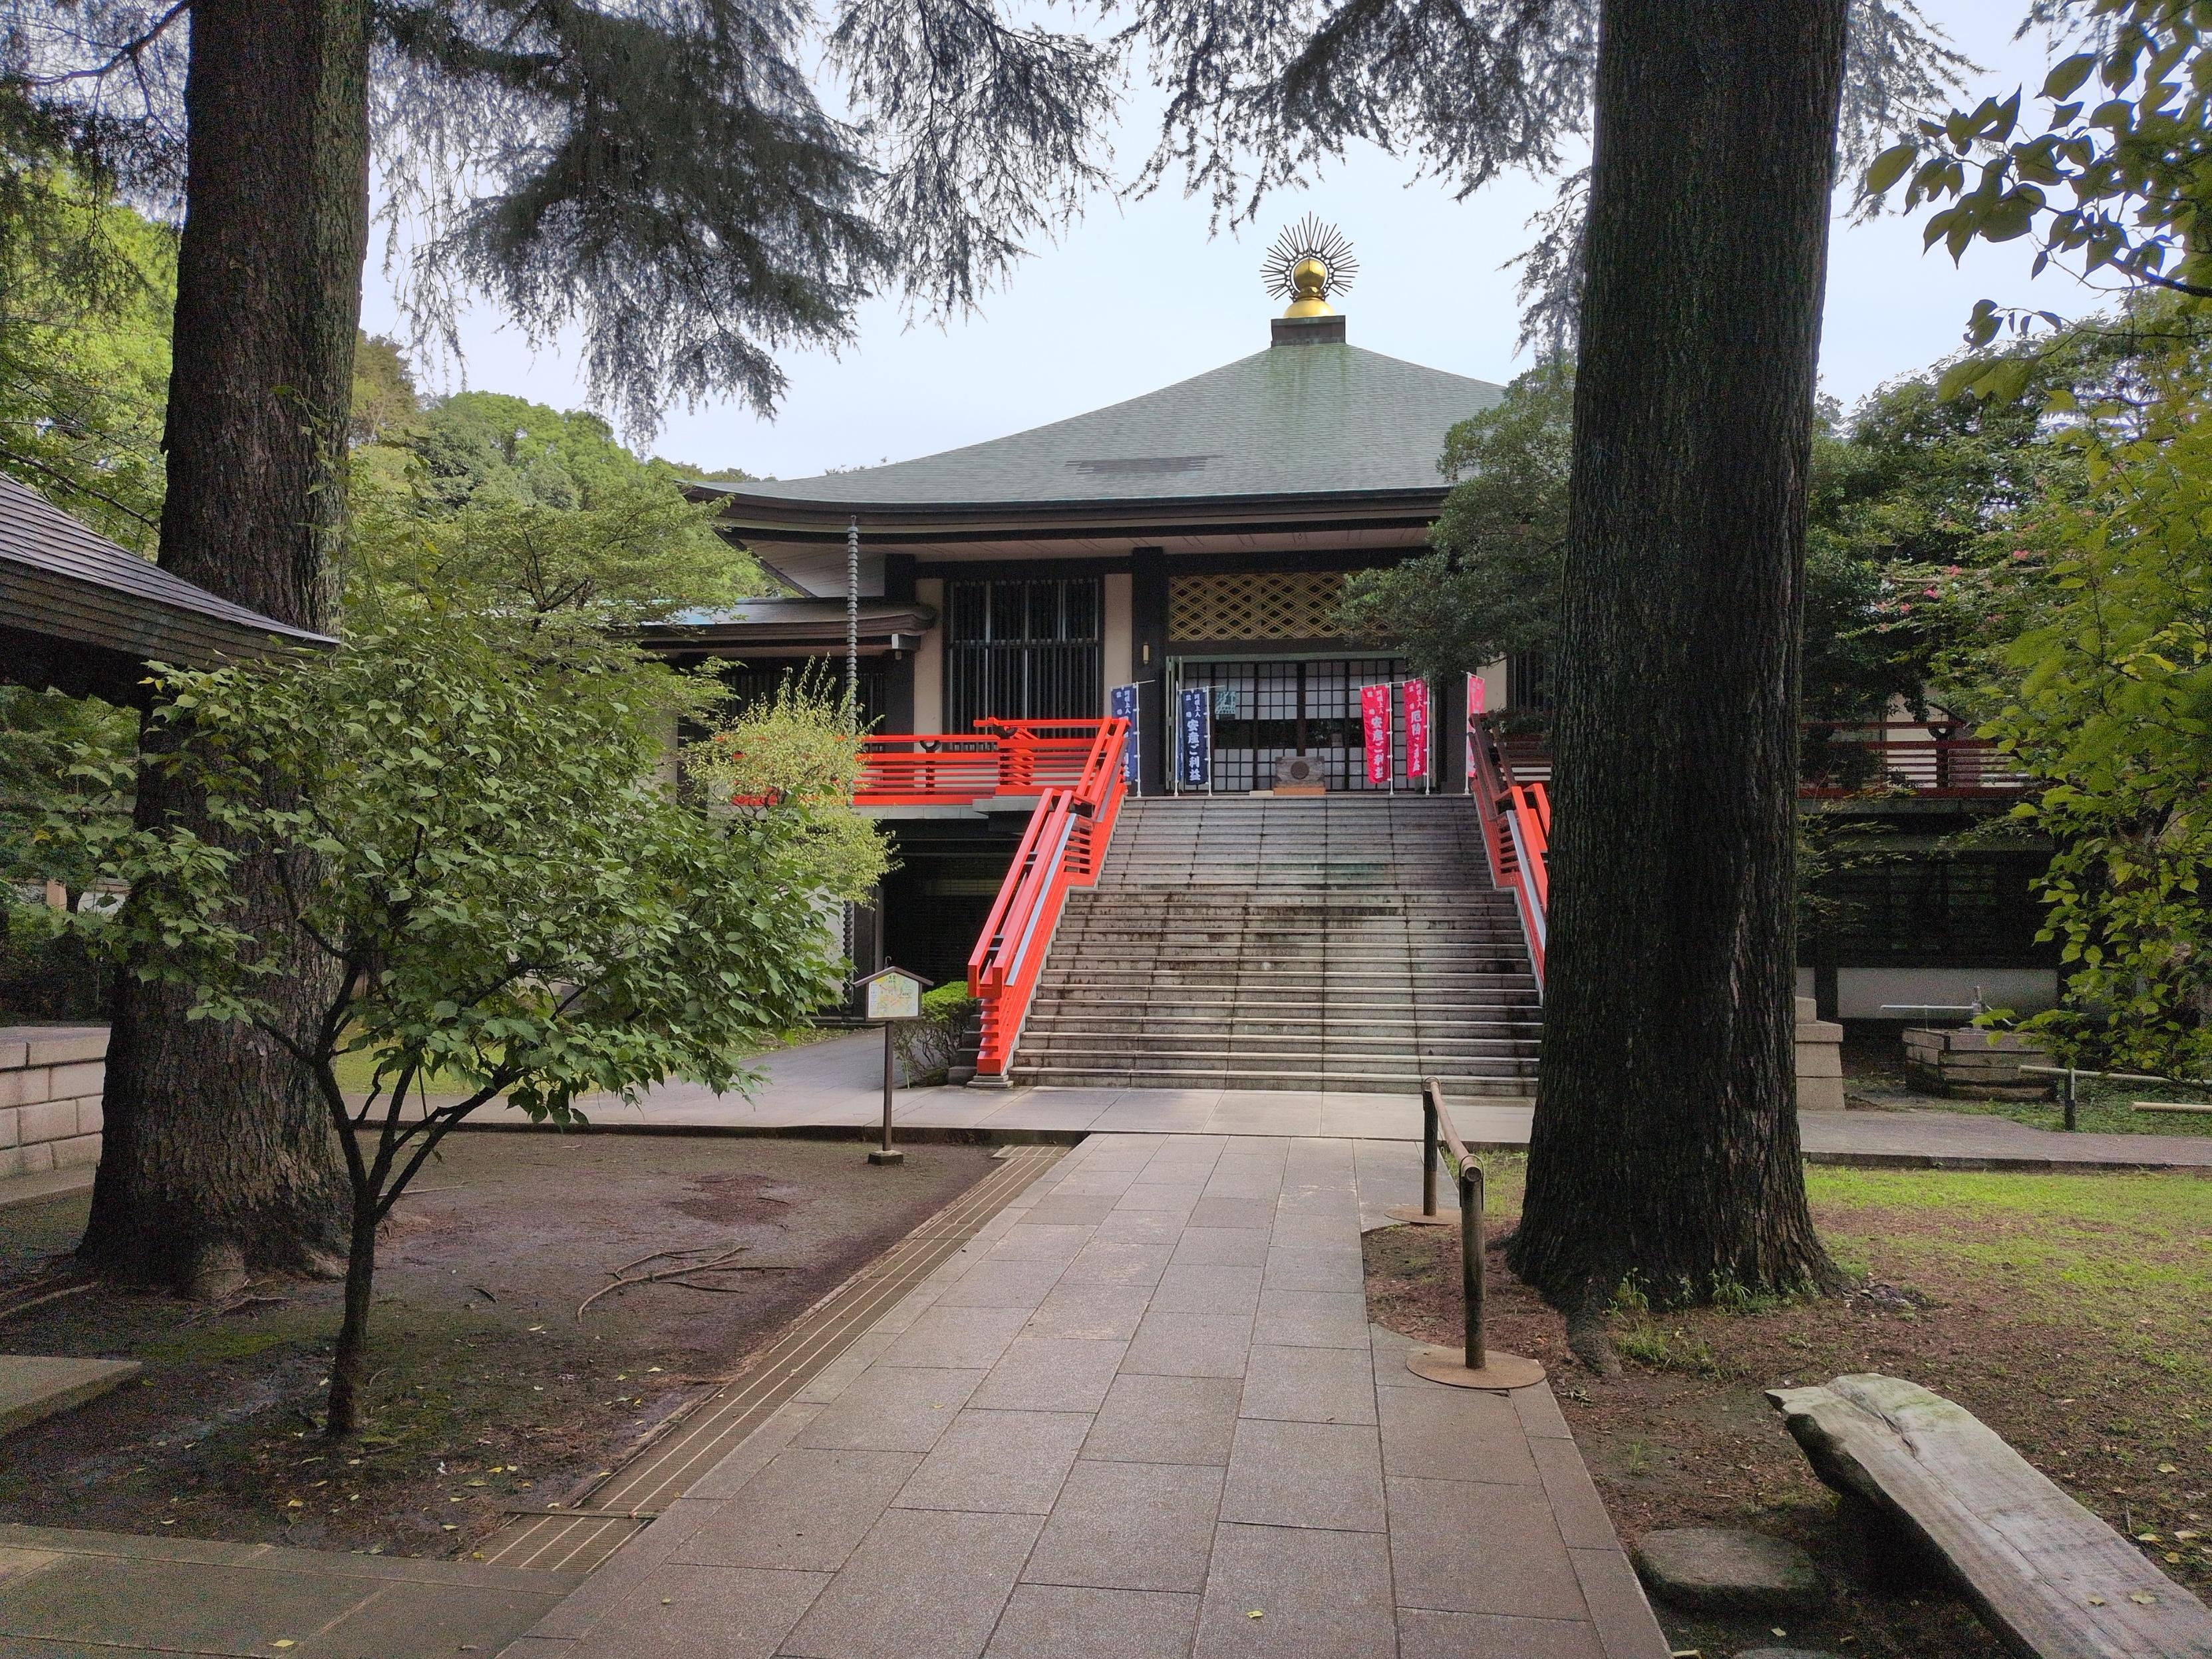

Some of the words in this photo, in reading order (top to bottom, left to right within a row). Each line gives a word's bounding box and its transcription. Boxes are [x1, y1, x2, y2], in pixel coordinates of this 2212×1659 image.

[1187, 719, 1201, 781] 安産ご利益
[1371, 716, 1384, 779] 安産ご利益
